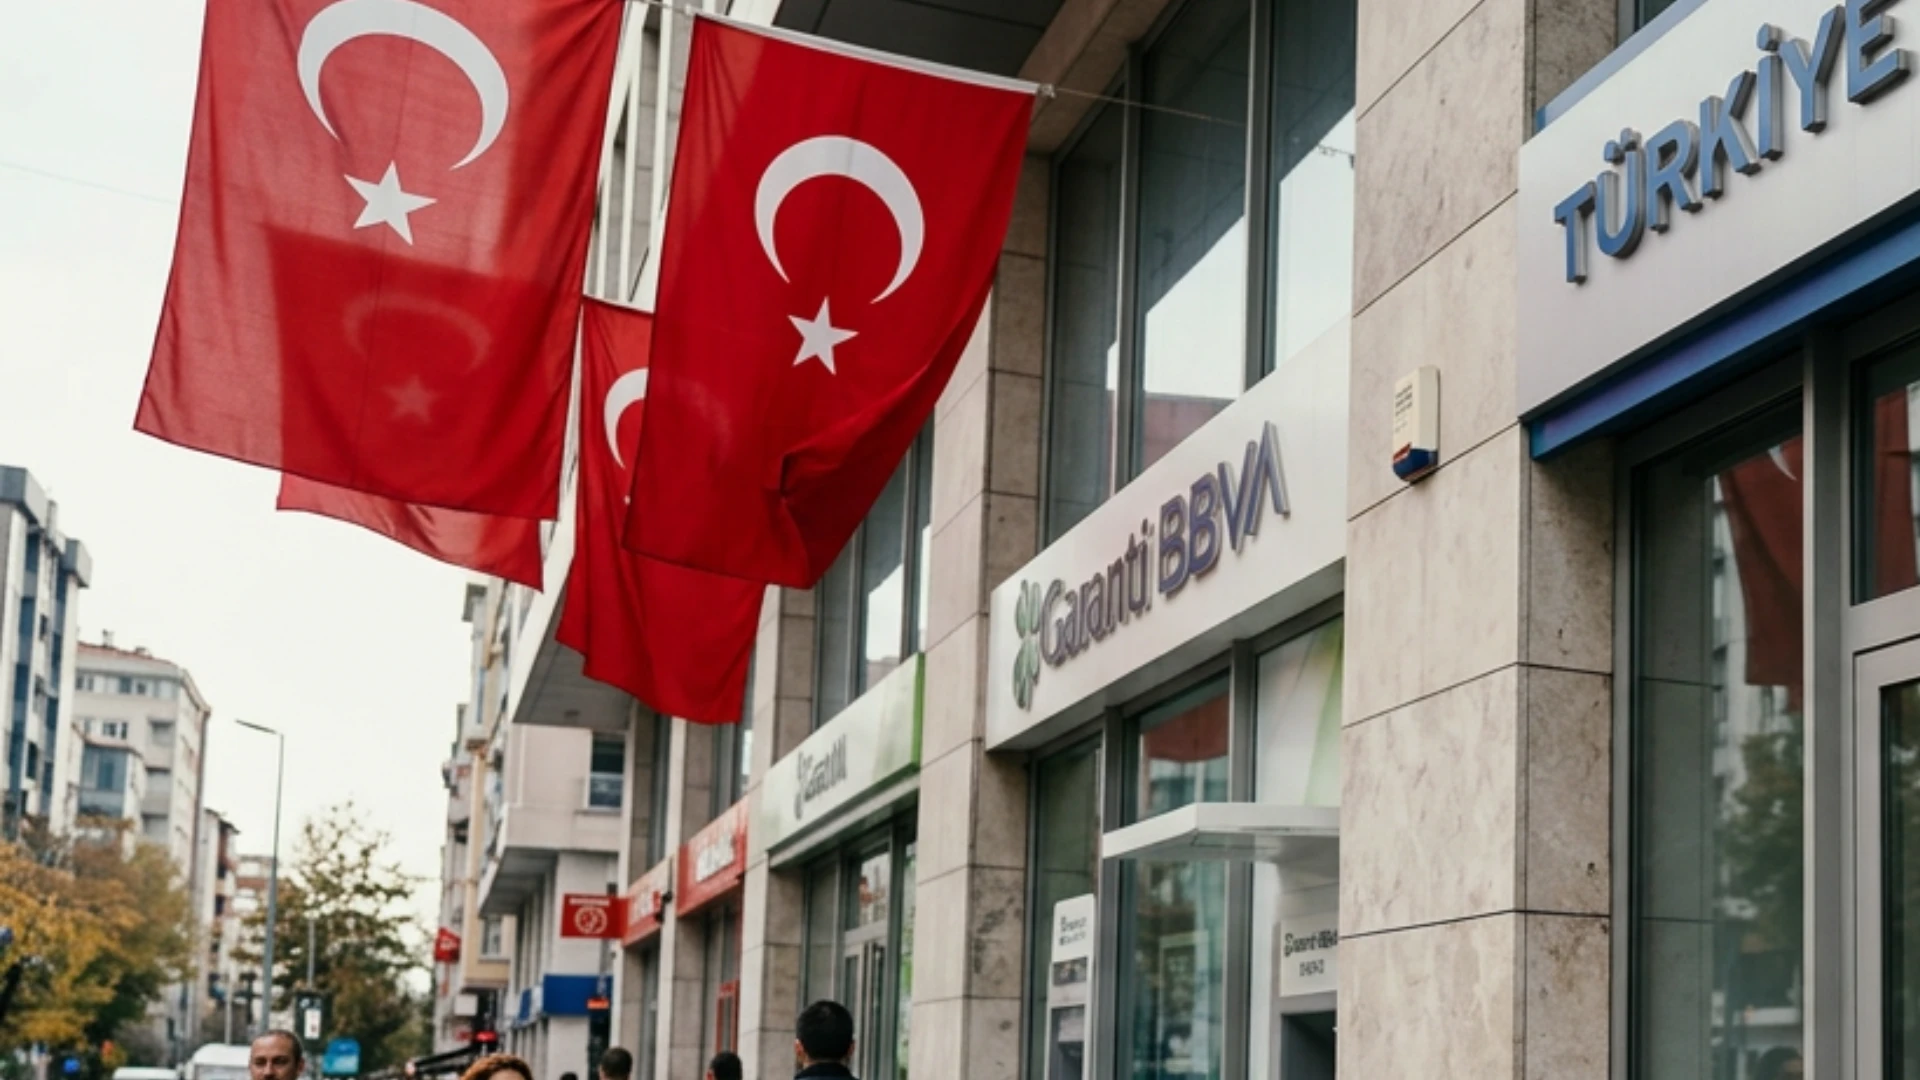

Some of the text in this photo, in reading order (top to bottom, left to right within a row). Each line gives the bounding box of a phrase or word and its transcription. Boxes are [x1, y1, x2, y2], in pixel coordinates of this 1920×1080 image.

[1553, 0, 1910, 284] TÜRKİYE
[1040, 420, 1291, 667] Garanti BBVA
